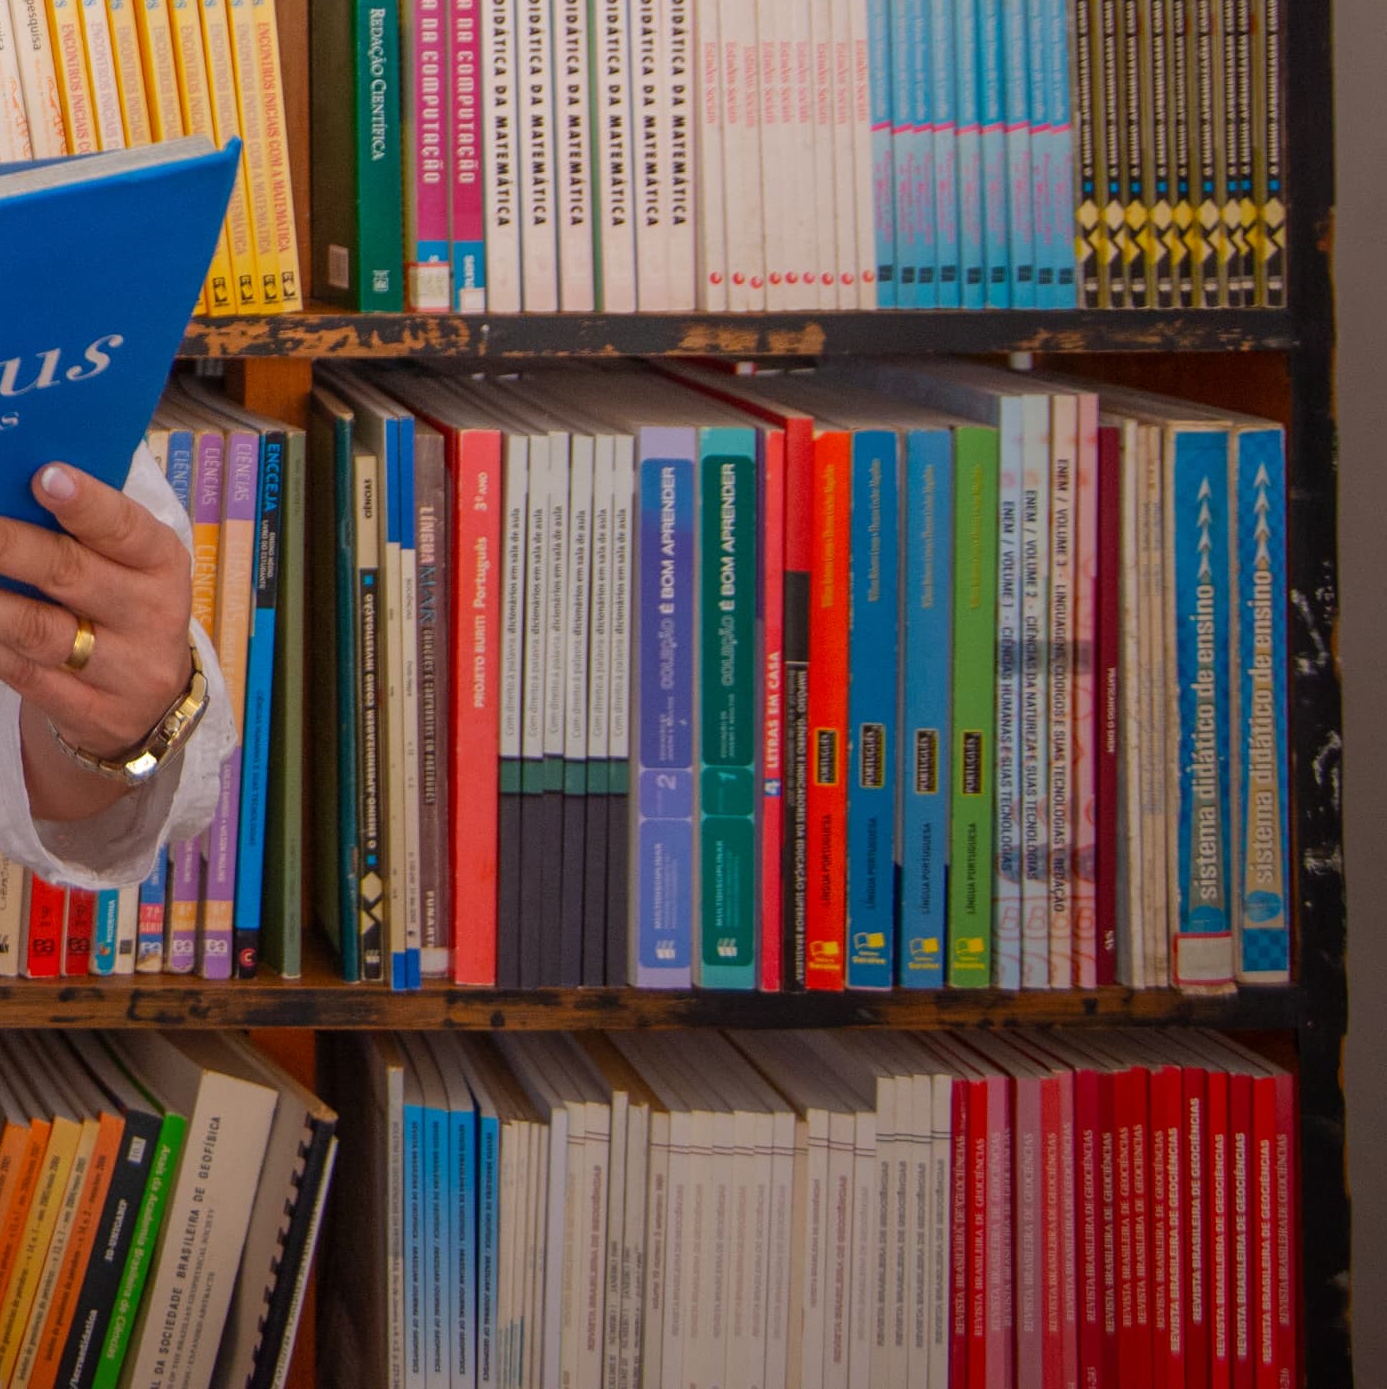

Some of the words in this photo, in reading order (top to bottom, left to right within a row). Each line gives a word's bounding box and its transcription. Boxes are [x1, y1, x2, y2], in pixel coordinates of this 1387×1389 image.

[367, 8, 386, 75] REDAÇÃO
[419, 18, 438, 42] NA
[370, 79, 388, 160] CIENTÍFICA
[418, 51, 442, 184] COMPUTAÇÃO
[494, 85, 506, 107] DA
[495, 116, 513, 226] MATEMÁTICA
[201, 448, 221, 505] CIÊNCIAS
[233, 443, 254, 501] CIÊNCIAS
[262, 443, 280, 512] ENCCEJA
[661, 466, 676, 554] APRENDER
[1002, 501, 1015, 531] ENEM
[472, 536, 490, 607] Português
[661, 559, 675, 595] BOM
[1001, 550, 1014, 598] VOLUME
[658, 604, 674, 613] É
[1192, 585, 1214, 662] ensino
[767, 651, 780, 689] CASA
[1000, 627, 1016, 680] CIÊNCIAS
[1189, 669, 1212, 696] de
[767, 693, 780, 715] EM
[999, 684, 1013, 742] HUMANAS
[766, 718, 780, 768] LETRAS
[999, 756, 1012, 787] SUAS
[1189, 704, 1213, 799] didático
[999, 790, 1012, 871] TECNOLOGIAS
[1193, 806, 1217, 899] sistema
[194, 1114, 221, 1179] GEOFÍSICA
[1190, 1098, 1201, 1176] GEOCIÊNCIAS
[192, 1186, 205, 1202] DE
[175, 1208, 200, 1278] BRASILEIRA
[1191, 1198, 1202, 1267] BRASILEIRA
[158, 1286, 183, 1354] SOCIEDADE
[1192, 1271, 1202, 1320] REVISTA
[153, 1358, 166, 1375] DA
